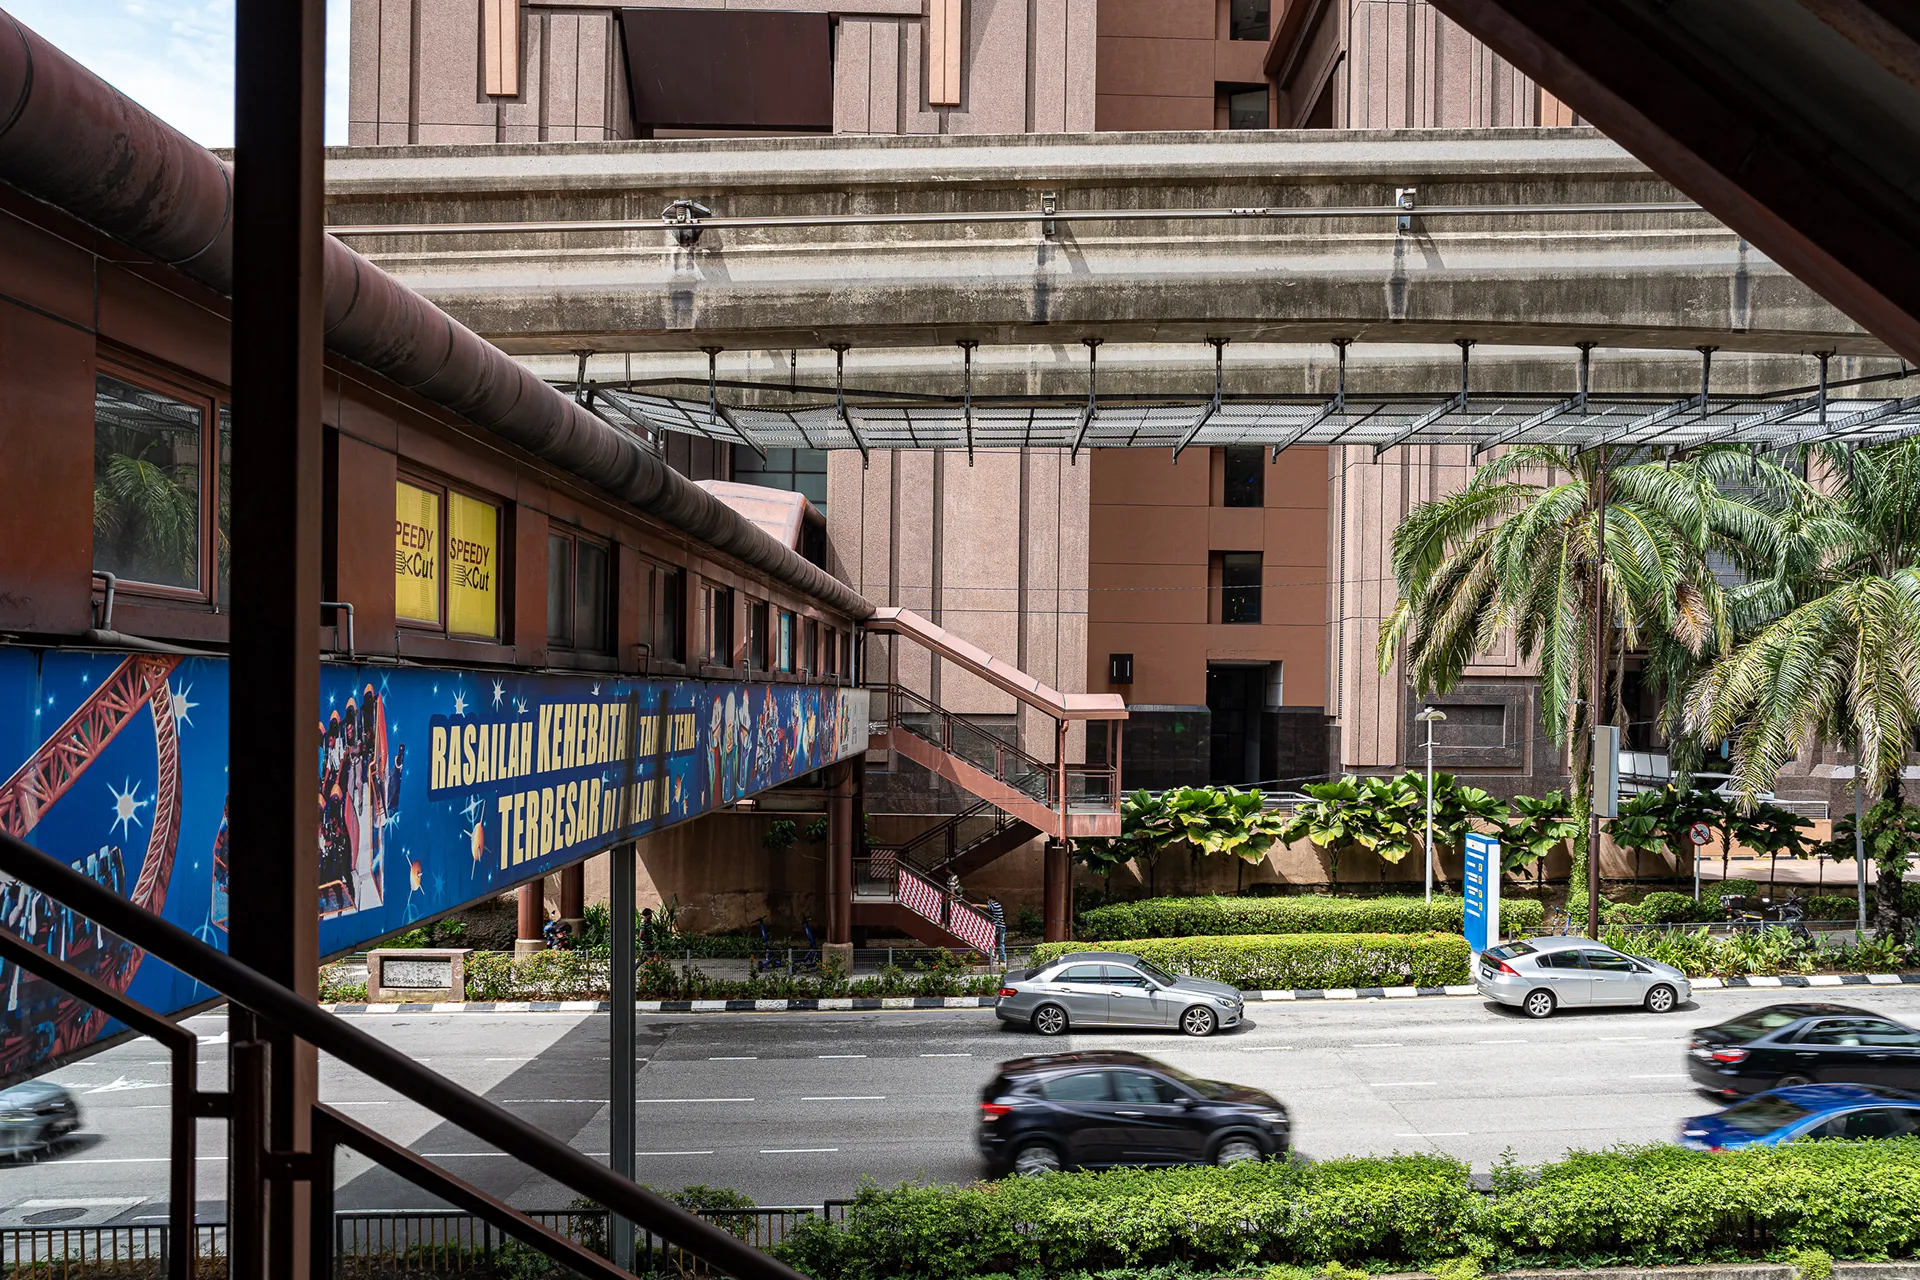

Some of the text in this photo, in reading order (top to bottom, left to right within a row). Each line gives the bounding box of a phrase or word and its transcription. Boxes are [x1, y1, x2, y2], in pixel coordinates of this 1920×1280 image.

[413, 551, 434, 580] Cut
[449, 537, 490, 567] SPEEDY
[472, 566, 490, 592] Cut
[431, 721, 533, 790] RASAILAH
[639, 714, 673, 757] TAMN
[674, 713, 696, 752] TEMA
[498, 775, 670, 871] TERBESAR DI ALAYIA
